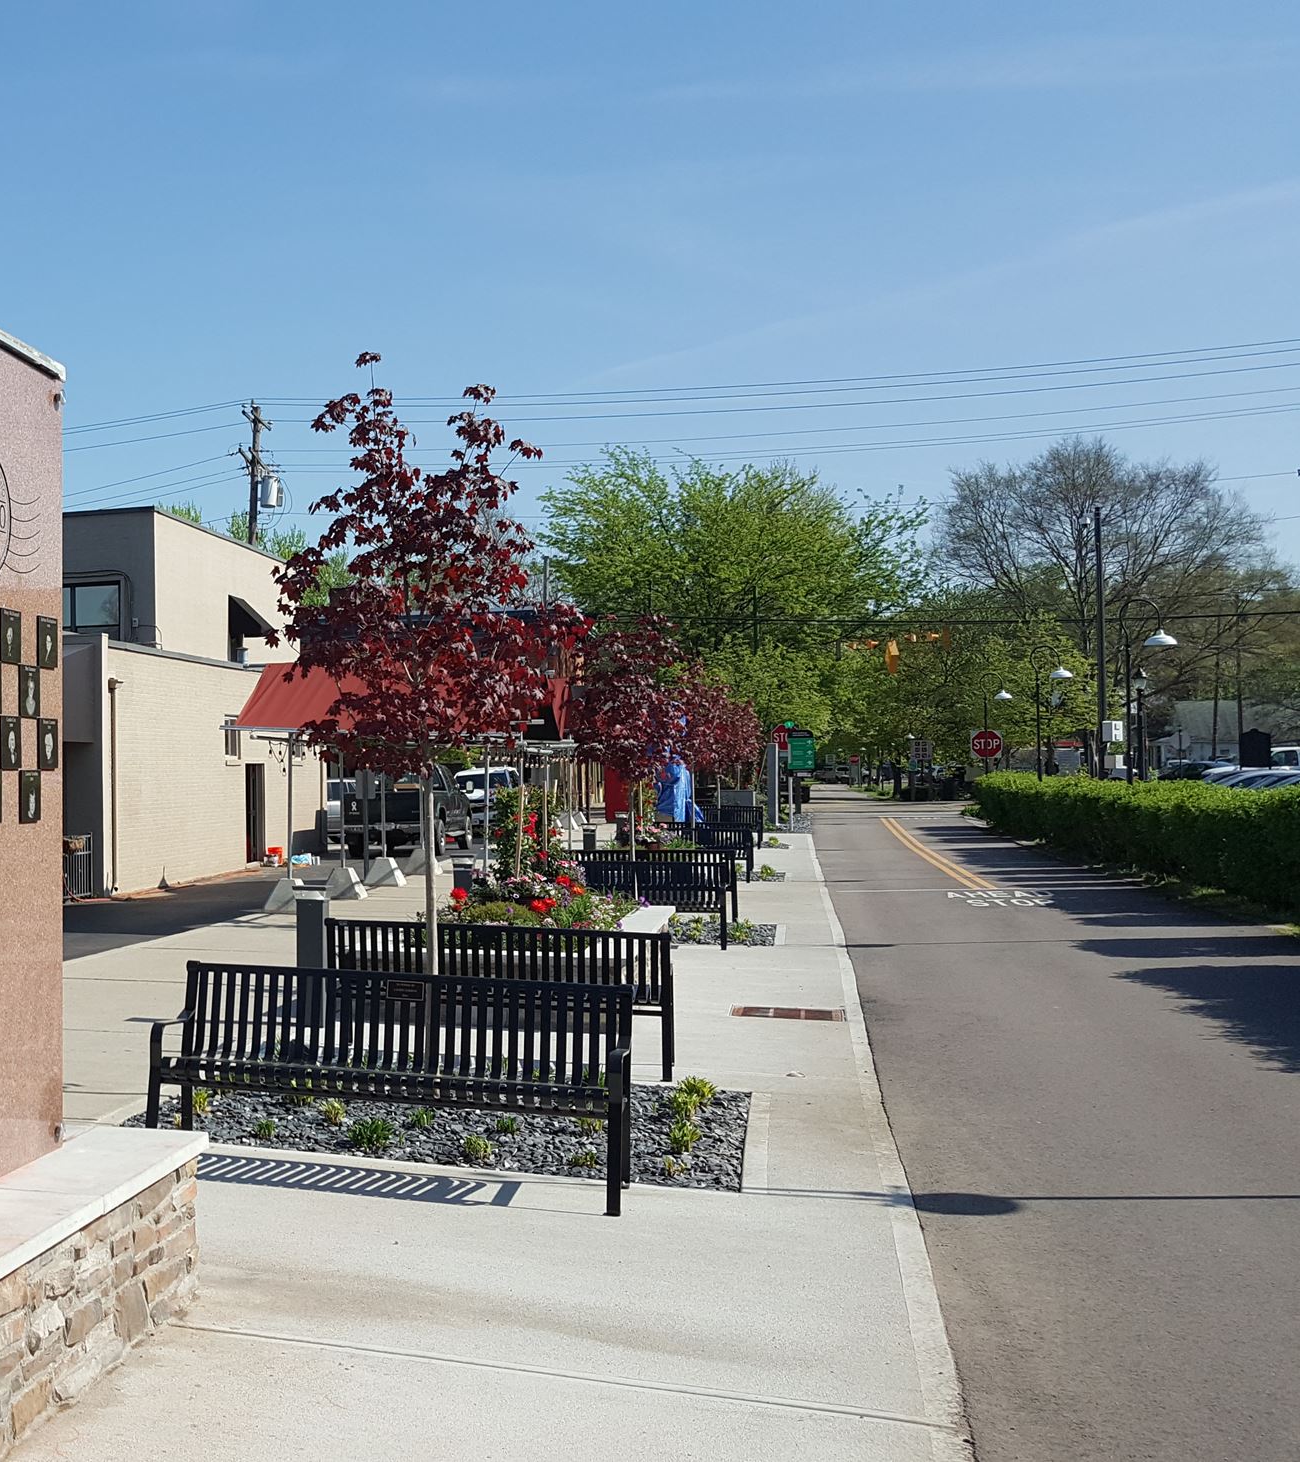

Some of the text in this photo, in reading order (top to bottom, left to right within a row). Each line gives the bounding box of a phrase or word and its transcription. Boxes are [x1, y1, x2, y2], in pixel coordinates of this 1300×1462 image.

[973, 738, 1000, 750] STOP
[947, 890, 1054, 899] AHEAD
[965, 899, 1055, 907] STOP
